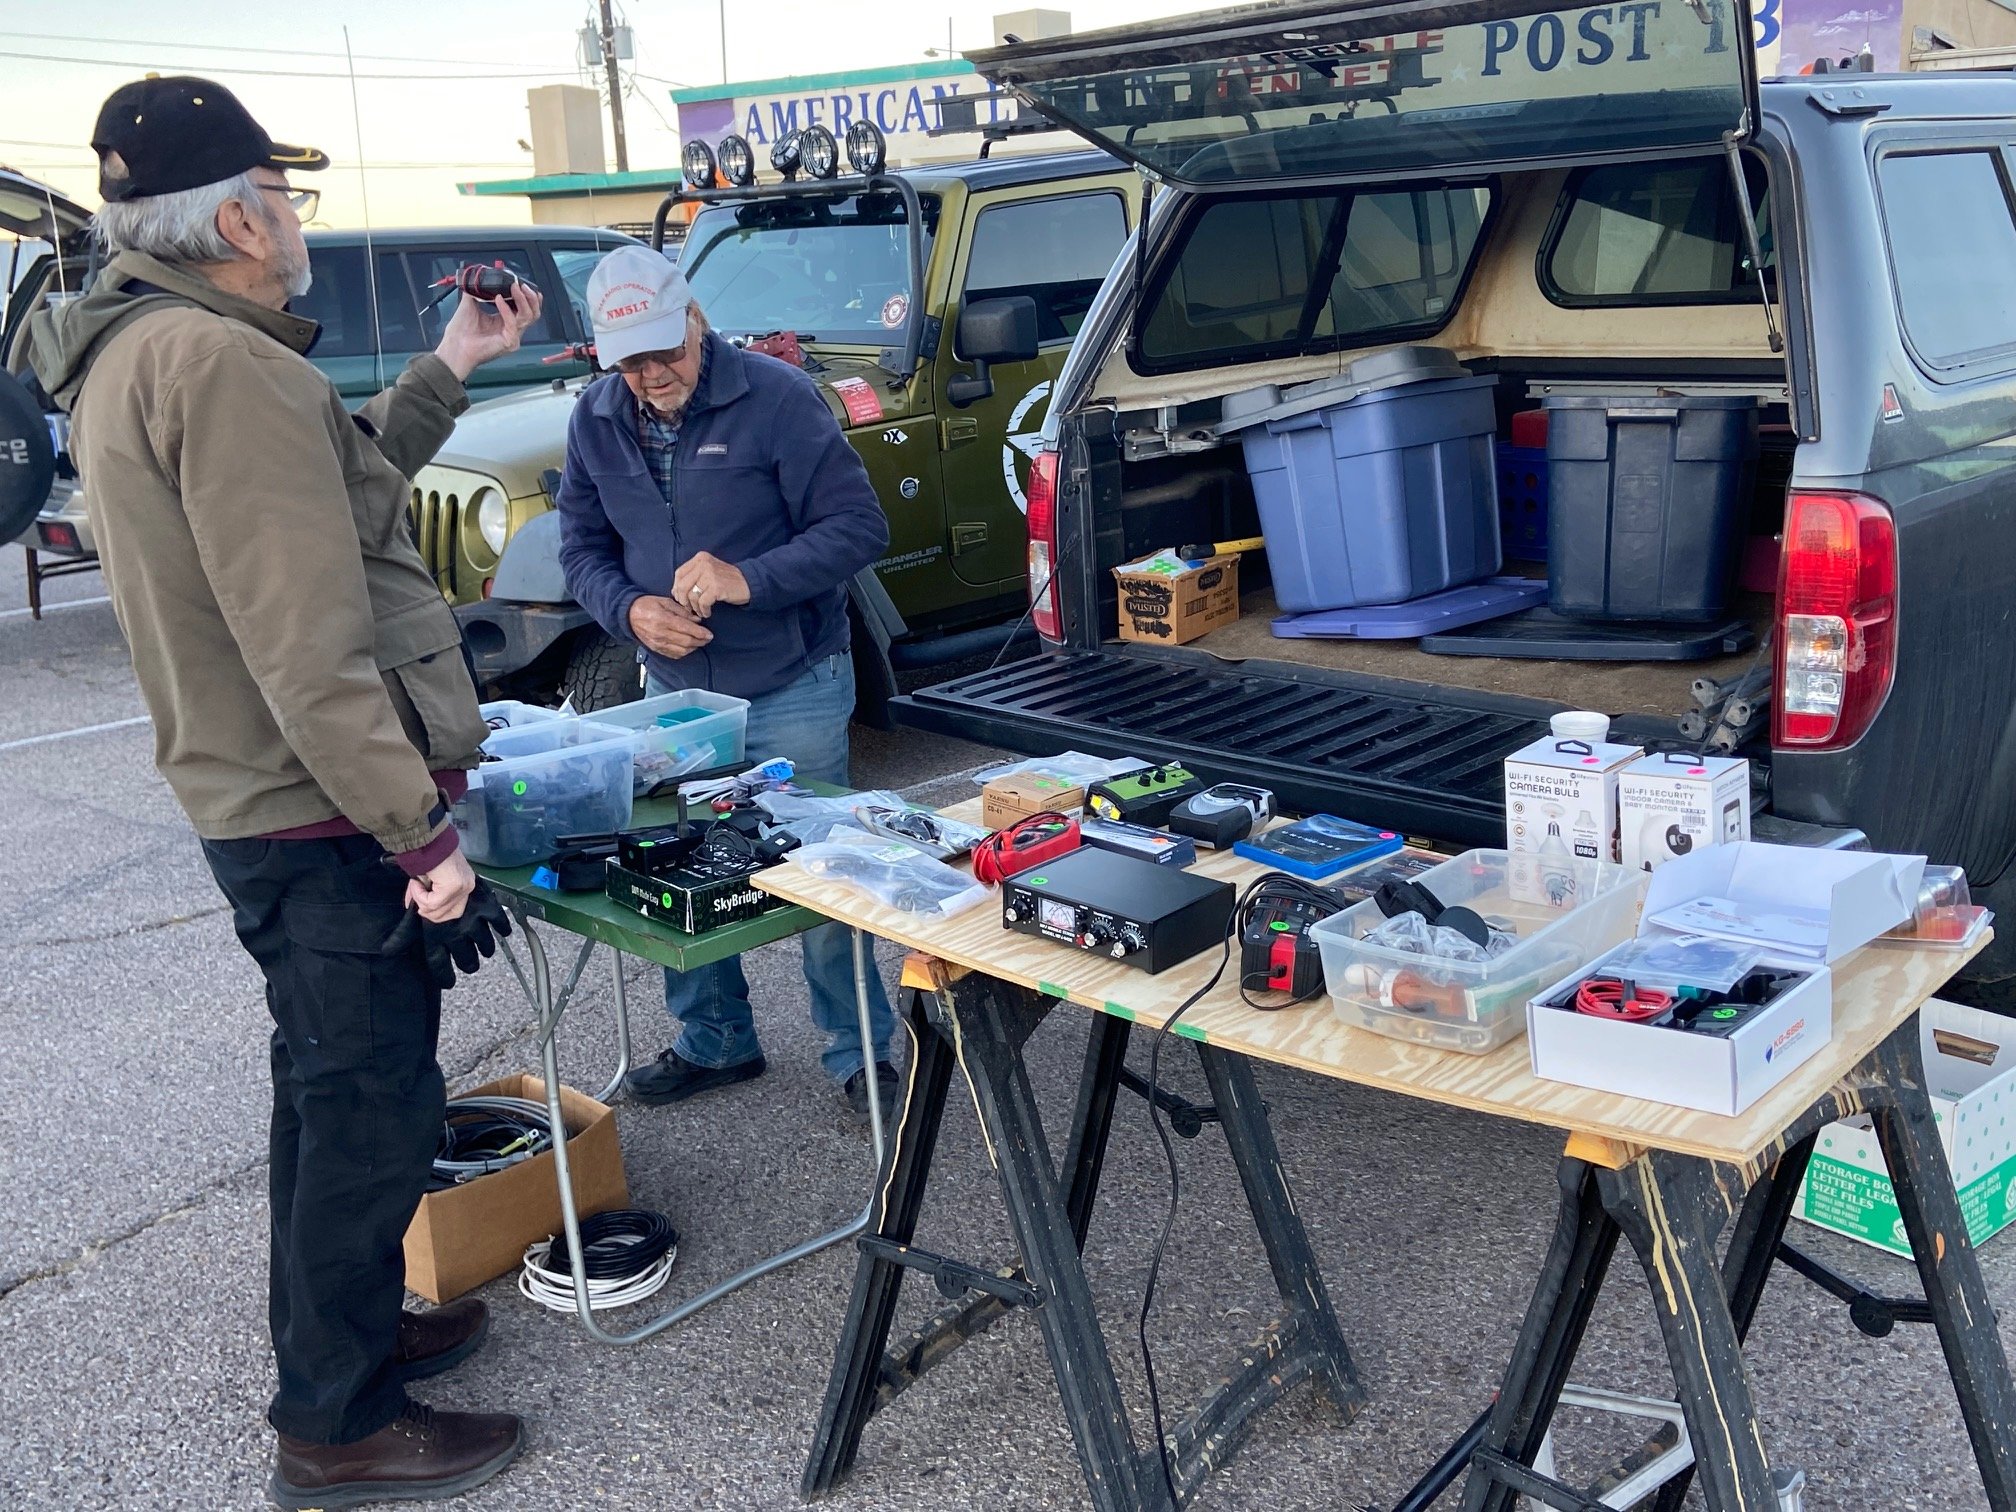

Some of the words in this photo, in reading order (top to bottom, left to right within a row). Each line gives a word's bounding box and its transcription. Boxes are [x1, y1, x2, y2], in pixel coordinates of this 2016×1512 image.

[1481, 3, 1660, 76] POST
[745, 82, 960, 145] AMERICAN
[605, 285, 622, 299] RADIO
[624, 283, 656, 297] OPERATOR
[607, 300, 649, 320] NM5LT
[870, 545, 943, 570] WRANGLER
[883, 556, 936, 574] UNLIMITED
[1128, 602, 1166, 616] CELESTIAL
[1509, 772, 1532, 781] WI-FI
[1535, 775, 1580, 787] SECURITY
[1509, 781, 1552, 795] CAMERA
[1554, 787, 1580, 799] BULB
[1624, 787, 1647, 796] WI-FI
[1650, 789, 1695, 800] SECURITY
[1624, 795, 1652, 803] INDOOR
[1654, 797, 1686, 806] CAMERA
[1645, 804, 1678, 812] MONITOR
[1576, 846, 1597, 857] 1080p
[650, 893, 658, 906] Easy
[713, 889, 764, 912] SkyBridge
[1813, 1159, 1870, 1185] STORAGE
[1873, 1179, 1894, 1193] BO
[1987, 1171, 2001, 1187] BOX
[1812, 1169, 1856, 1192] LETTER
[1866, 1188, 1898, 1207] LEGA
[1812, 1181, 1838, 1197] SIZE
[1840, 1191, 1875, 1210] FILES
[1983, 1180, 2002, 1199] LEGAL
